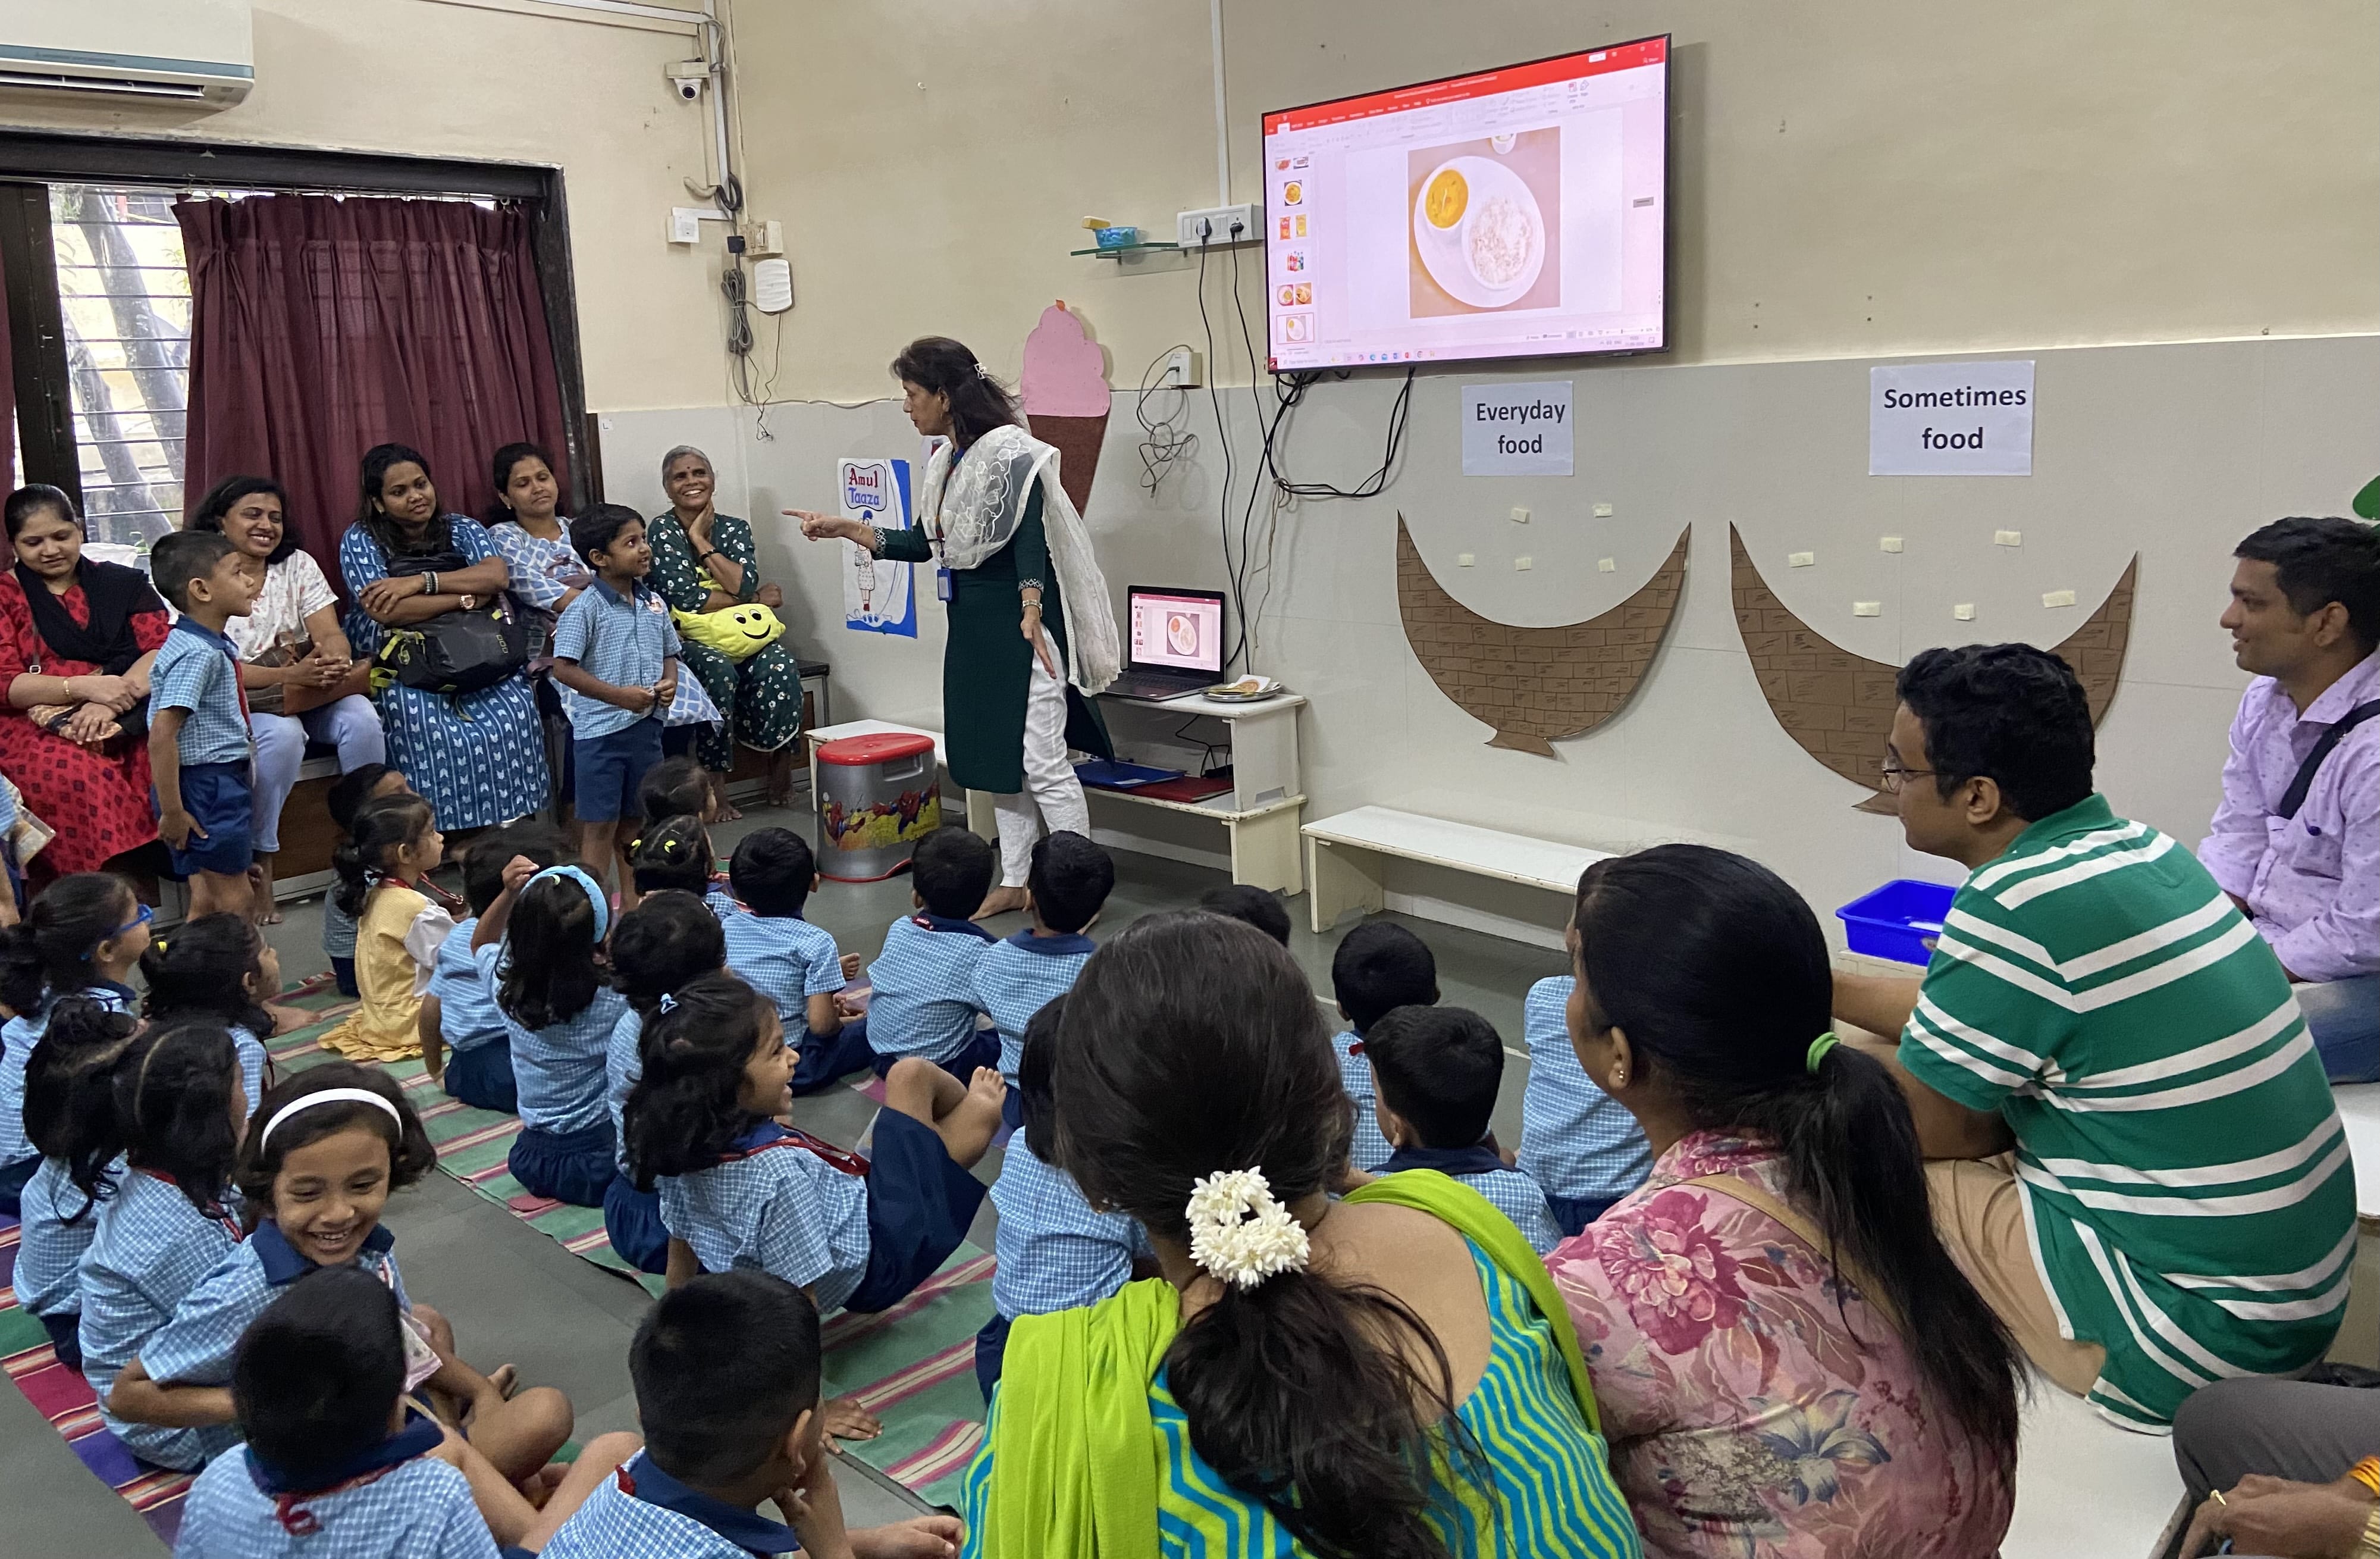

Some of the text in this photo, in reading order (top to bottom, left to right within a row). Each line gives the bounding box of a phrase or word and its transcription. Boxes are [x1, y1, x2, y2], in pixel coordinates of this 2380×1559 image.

[1884, 386, 2026, 409] Sometimes
[1476, 399, 1566, 425] Everyday
[1498, 434, 1542, 454] food
[1922, 427, 1984, 450] food
[848, 468, 878, 488] Amul
[848, 487, 879, 506] Taaza
